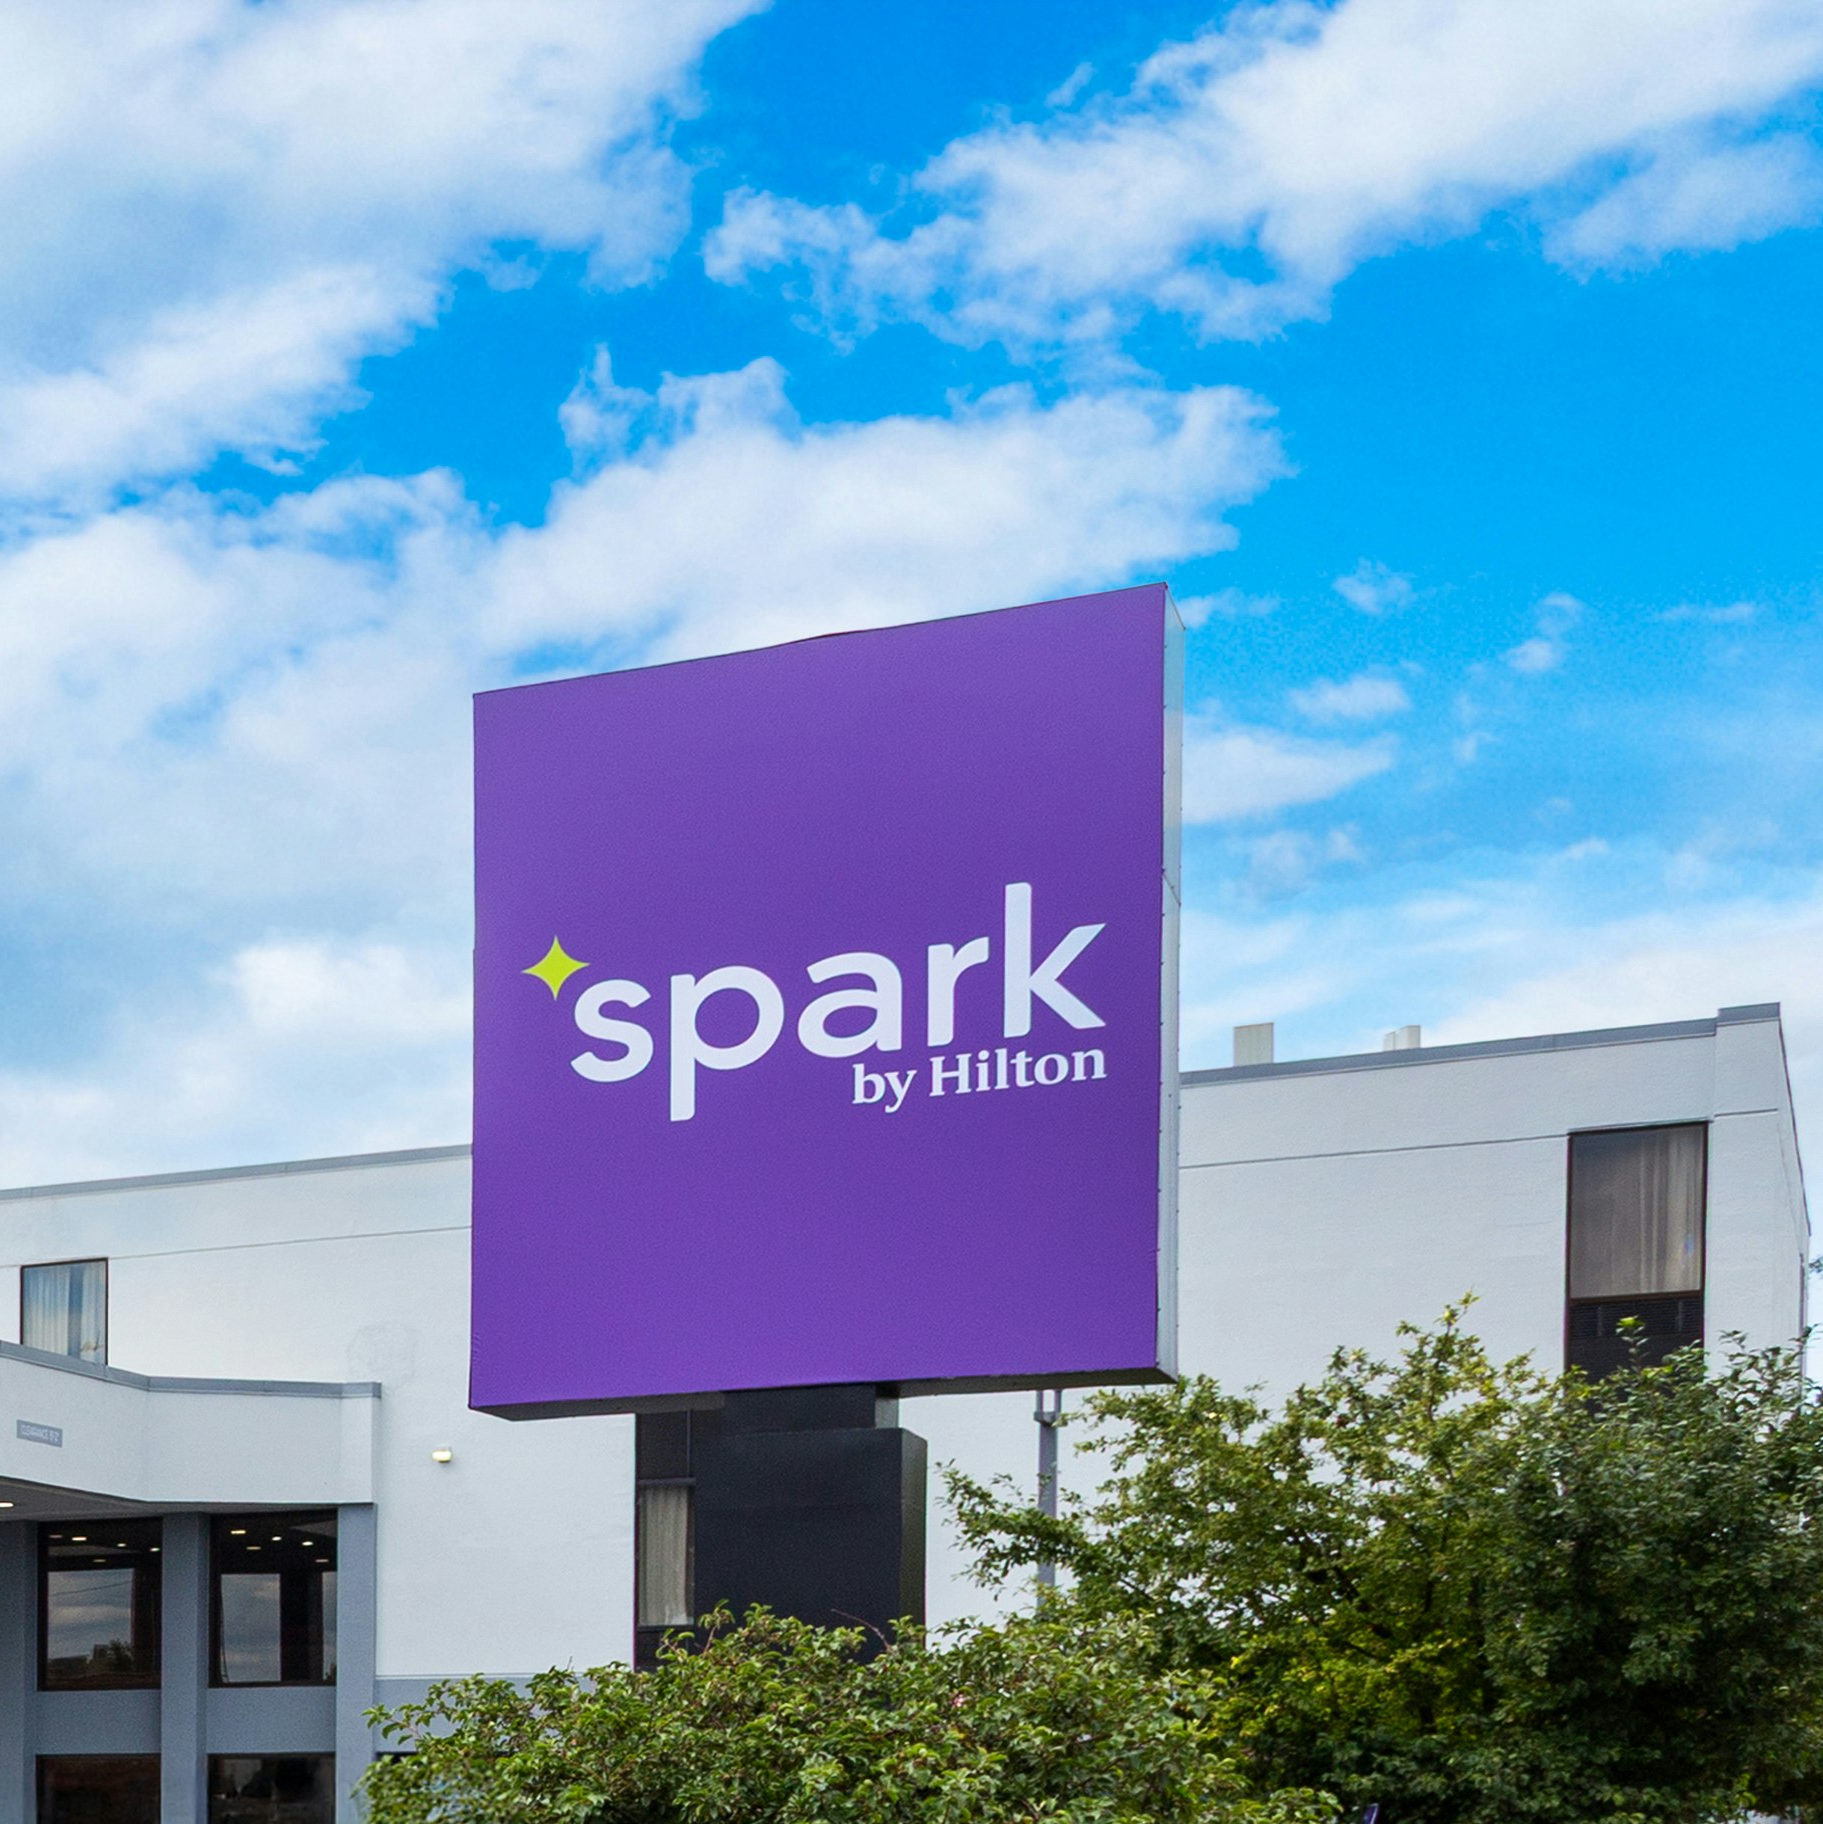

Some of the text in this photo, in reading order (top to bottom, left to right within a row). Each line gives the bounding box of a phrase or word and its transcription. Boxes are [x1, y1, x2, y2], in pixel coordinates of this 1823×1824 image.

[570, 882, 1107, 1122] spark
[852, 1048, 1107, 1113] by Hilton
